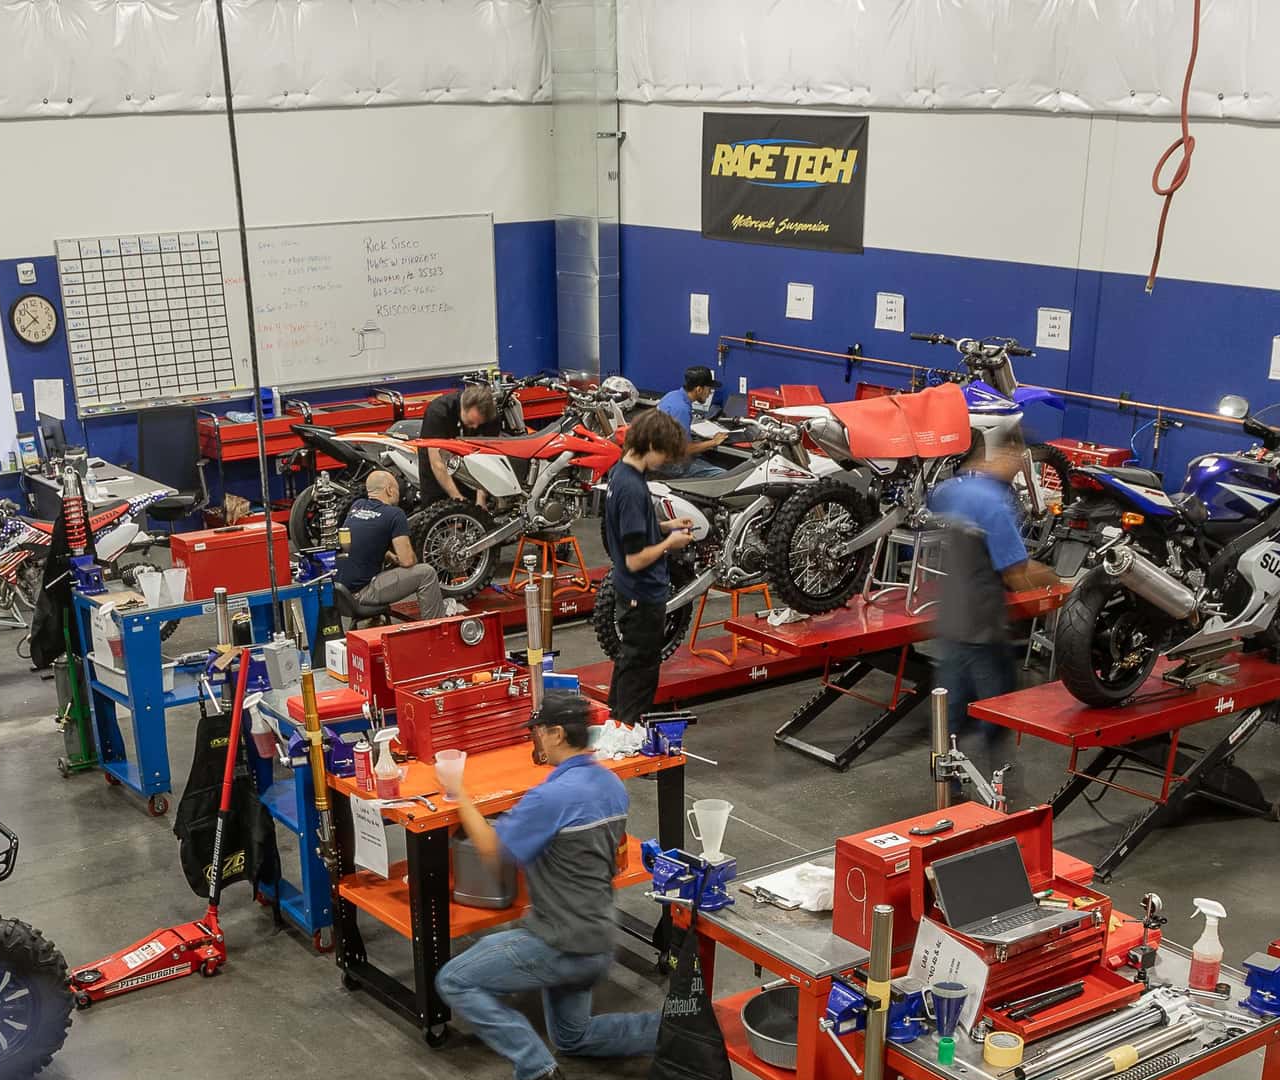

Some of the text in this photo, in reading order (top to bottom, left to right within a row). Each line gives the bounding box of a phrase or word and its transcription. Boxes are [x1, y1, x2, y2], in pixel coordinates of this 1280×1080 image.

[711, 143, 858, 184] RACE TECH
[731, 214, 830, 234] Motorcycle Suspension
[120, 967, 176, 989] PITTSBURGH
